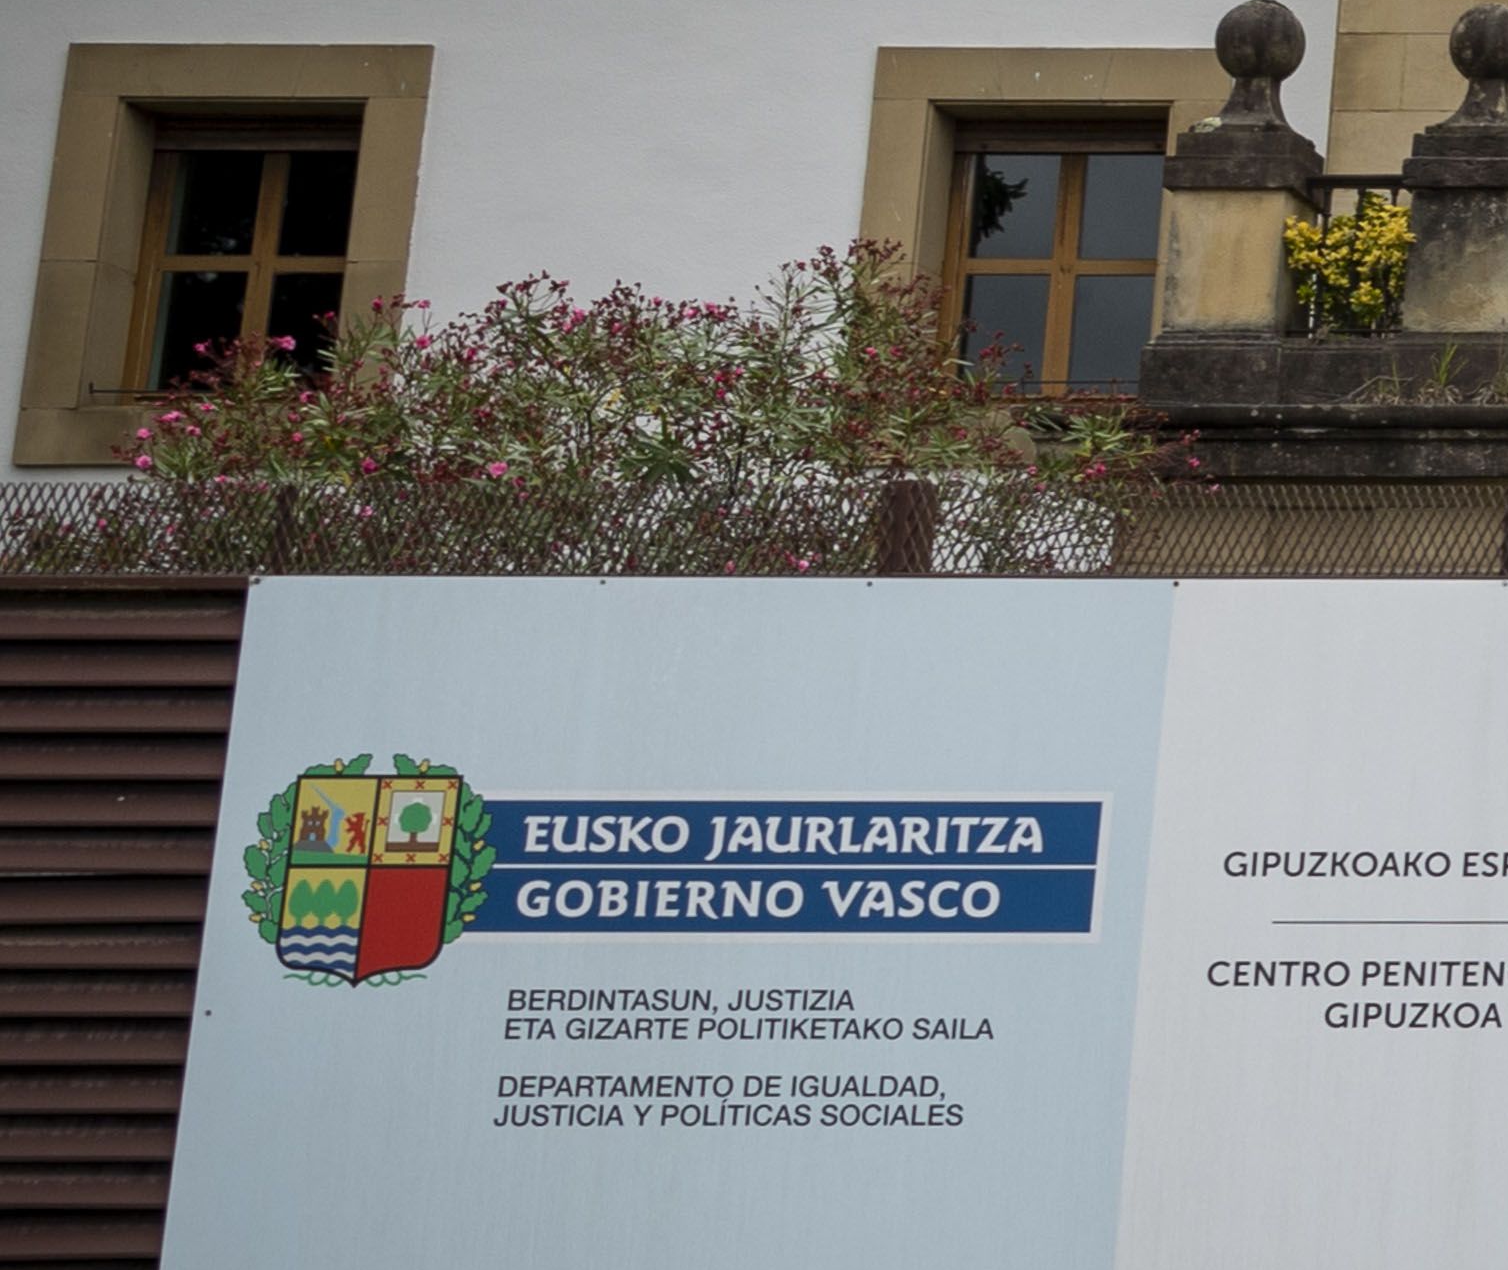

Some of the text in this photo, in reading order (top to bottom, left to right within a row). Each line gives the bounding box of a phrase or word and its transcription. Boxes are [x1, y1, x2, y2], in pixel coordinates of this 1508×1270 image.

[524, 815, 1043, 861] EUSKO JAURLARITZA
[1223, 850, 1452, 878] GIPUZKOAKO
[517, 880, 1000, 920] GOBIERNO VASCO
[1206, 960, 1351, 988] CENTRO
[507, 988, 855, 1016] BERDINTASUN, JUSTIZIA
[1324, 1001, 1503, 1029] GIPUZKOA
[504, 1017, 994, 1041] ETA GIZARTE POLITIKETAKO SAILA
[497, 1074, 946, 1102] DEPARTAMENTO DE IGUALDAD,
[492, 1097, 964, 1128] JUSTICIA Y POLÍTICAS SOCIALES
